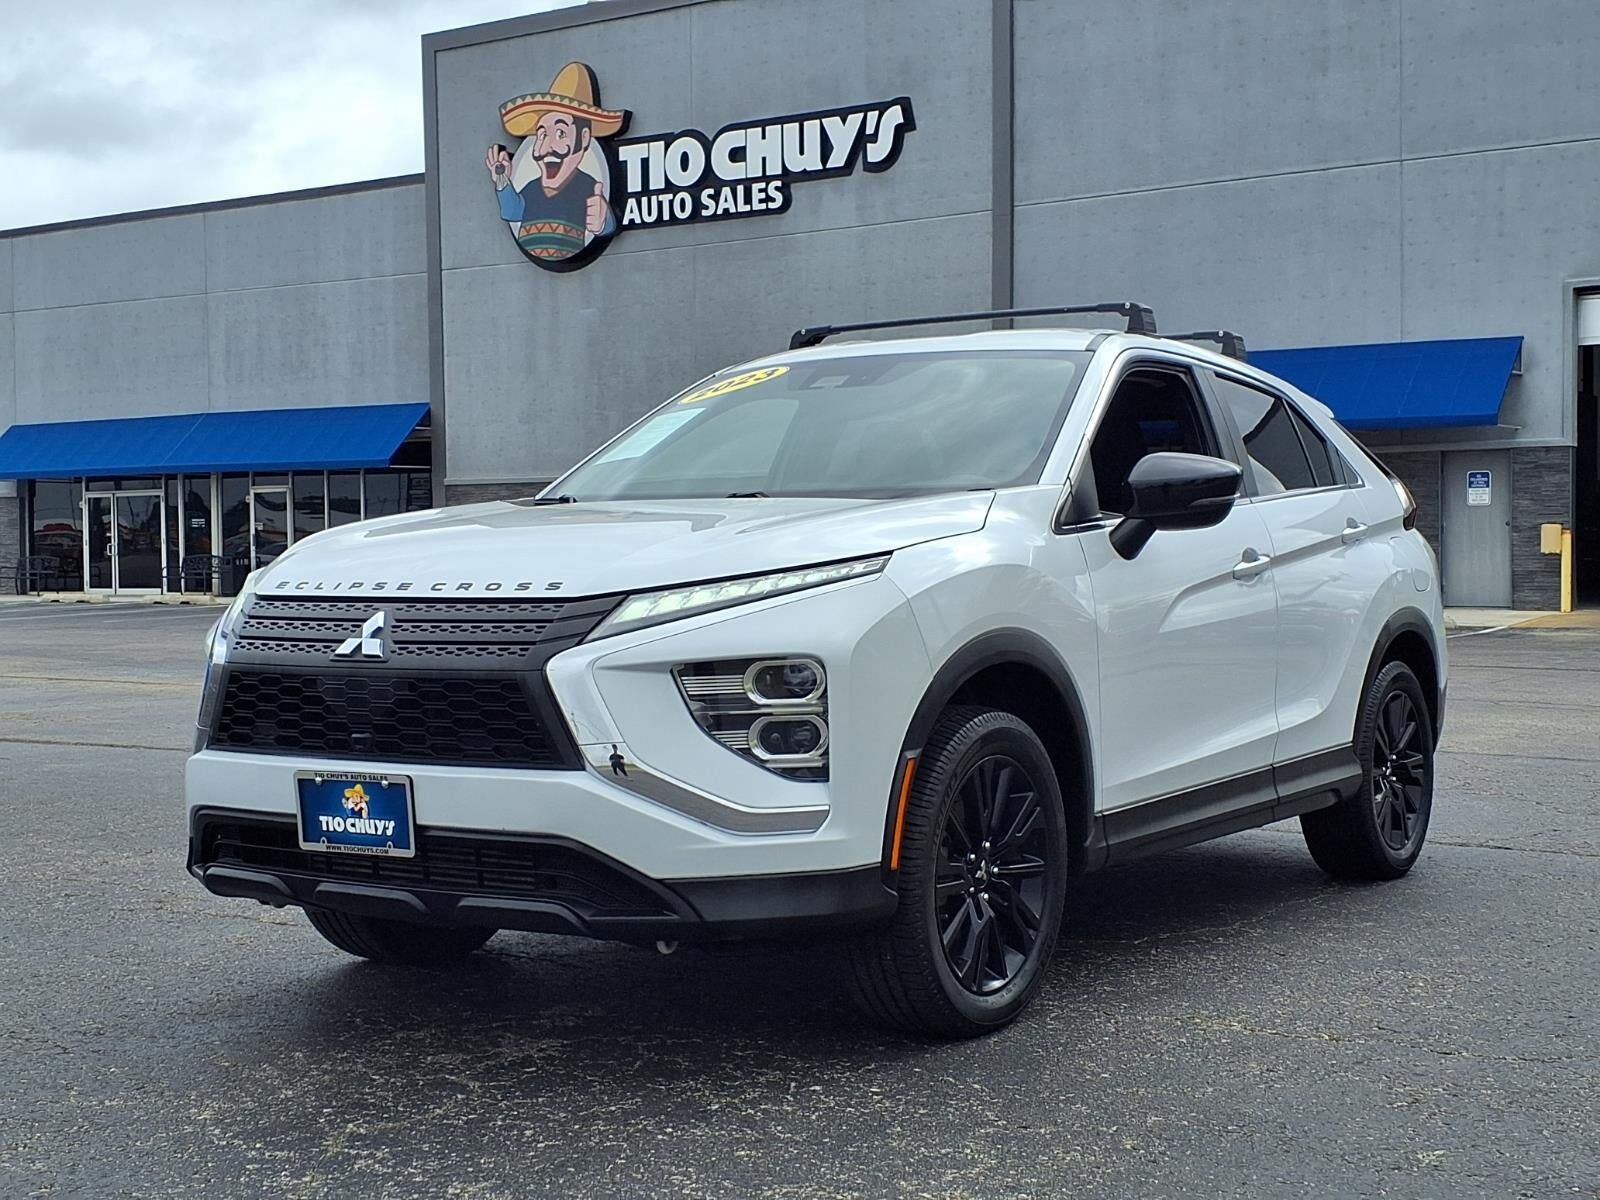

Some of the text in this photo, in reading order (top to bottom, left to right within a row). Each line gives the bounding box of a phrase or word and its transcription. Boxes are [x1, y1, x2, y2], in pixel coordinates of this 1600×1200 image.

[619, 104, 905, 193] TIO CHUY'S
[622, 180, 783, 225] AUTO SALES
[688, 368, 779, 401] 2023
[275, 581, 564, 592] ECLIPSE CROSS
[319, 815, 395, 836] TIO CHUY'S
